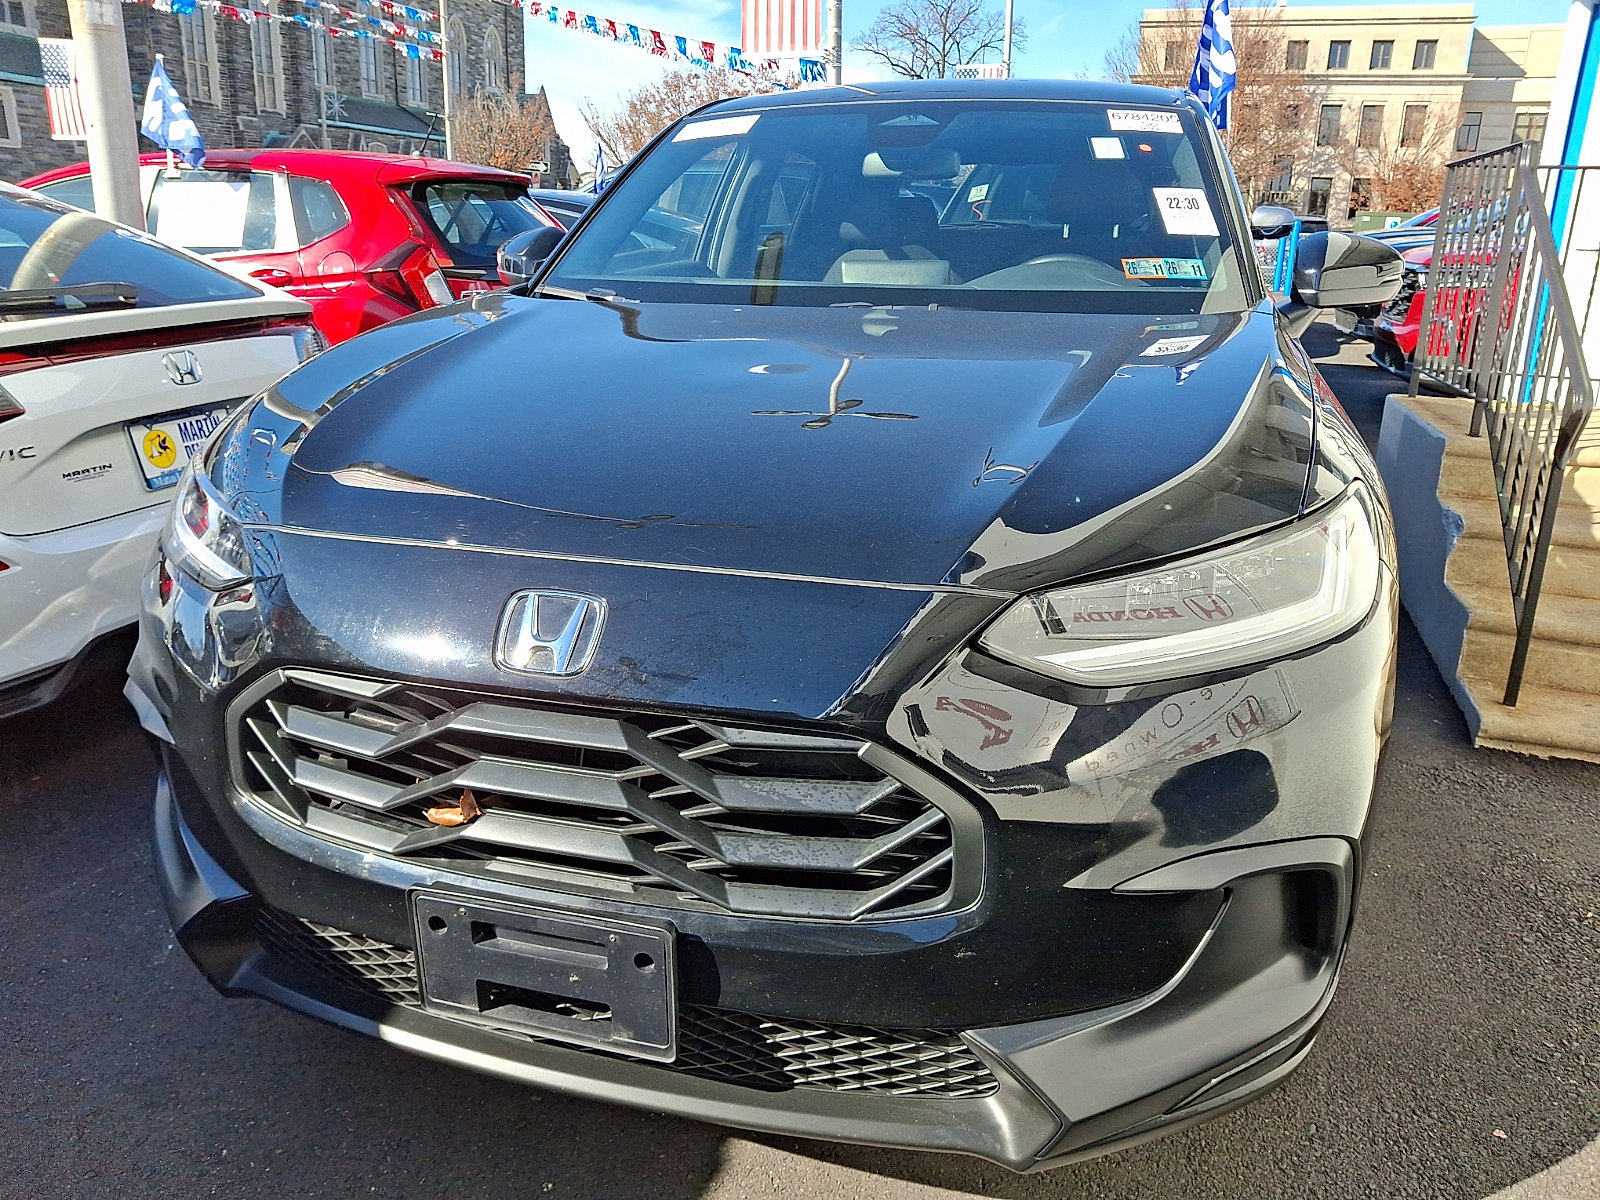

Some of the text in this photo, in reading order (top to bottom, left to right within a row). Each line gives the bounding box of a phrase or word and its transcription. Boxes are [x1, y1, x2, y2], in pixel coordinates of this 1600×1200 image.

[1166, 197, 1199, 210] 22:30
[1126, 261, 1138, 275] 26
[1166, 261, 1178, 275] 26
[62, 463, 112, 479] MARTIN
